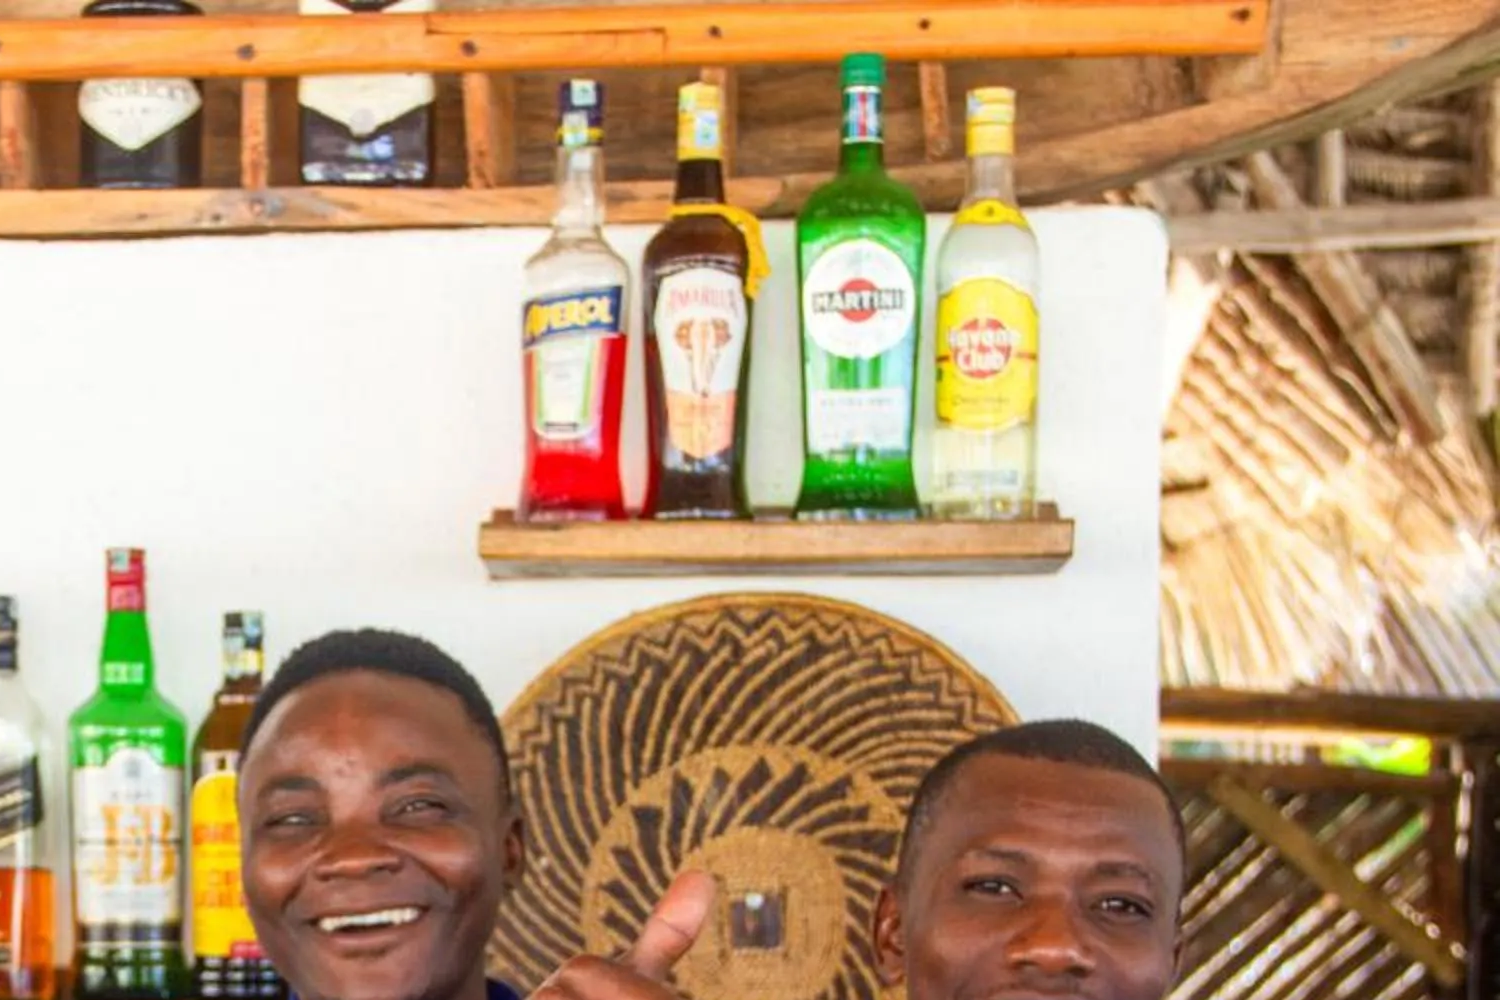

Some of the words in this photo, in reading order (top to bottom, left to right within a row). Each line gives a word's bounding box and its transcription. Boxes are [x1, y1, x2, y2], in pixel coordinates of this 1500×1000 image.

[812, 288, 905, 313] MARTINI
[524, 296, 615, 337] APEROL
[948, 326, 1021, 349] Havana
[957, 345, 1005, 373] Club
